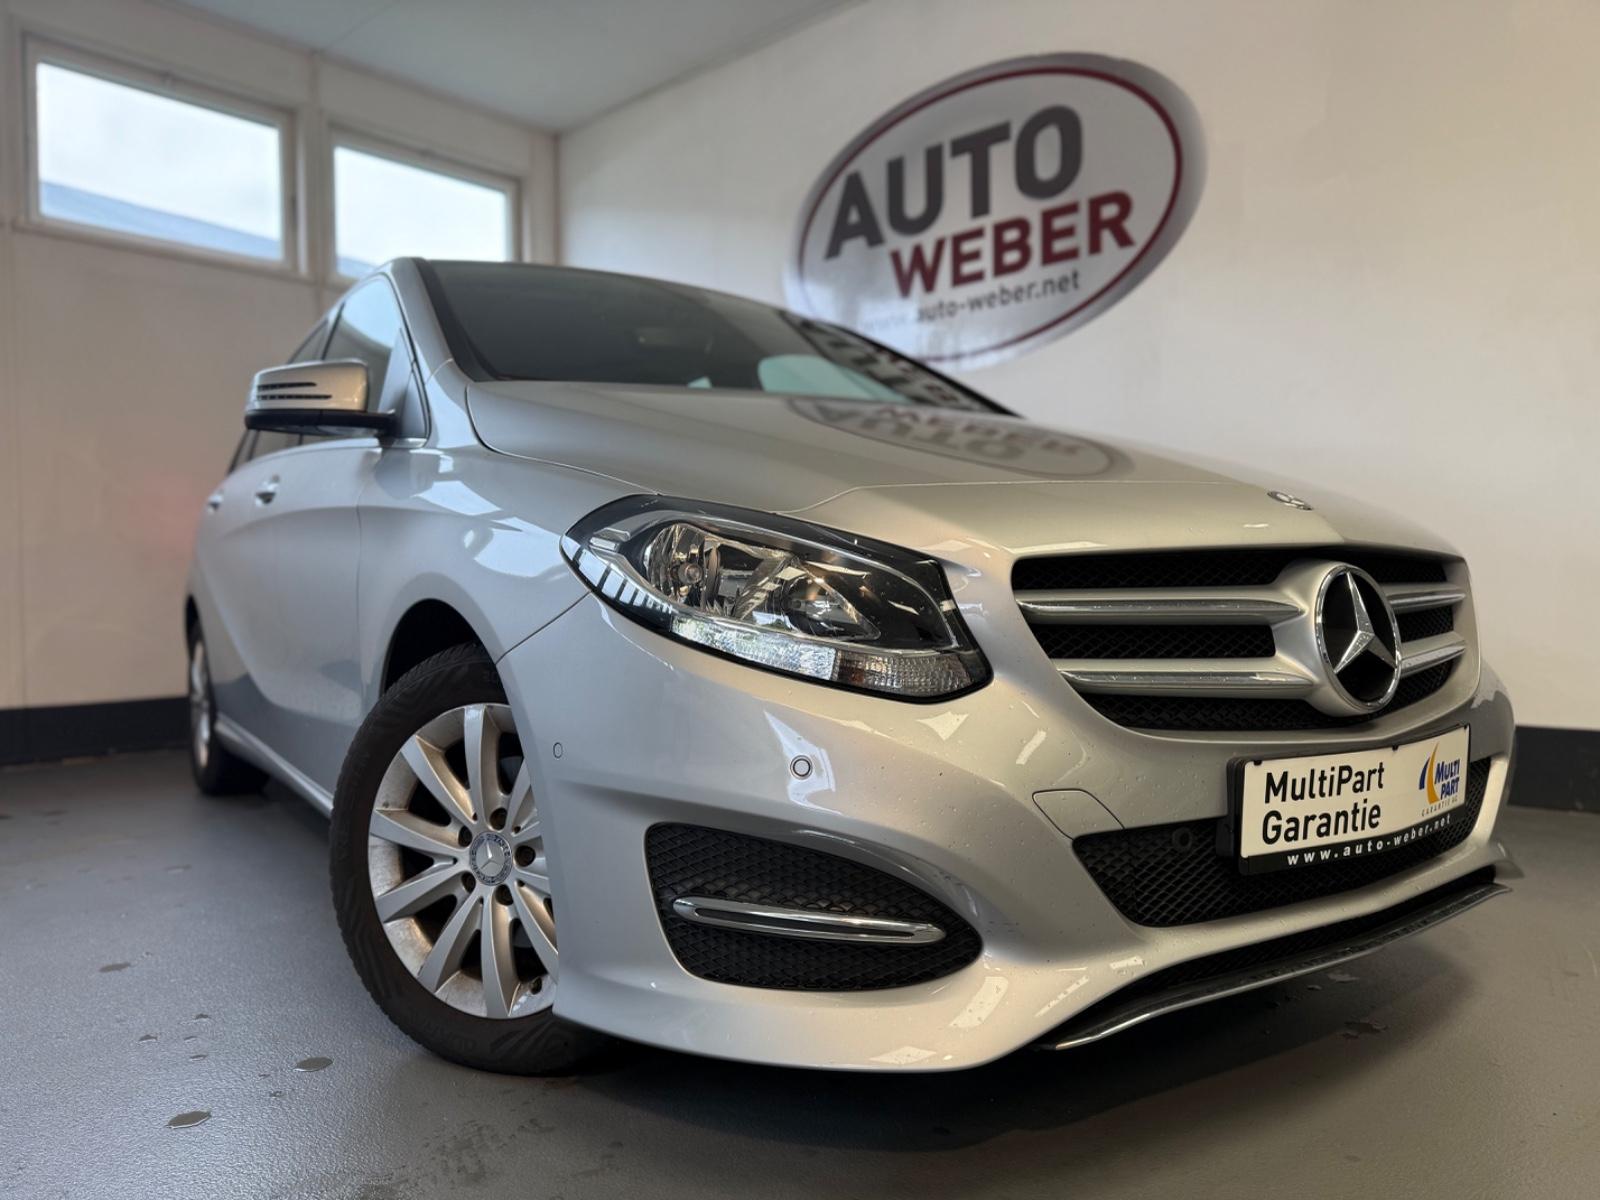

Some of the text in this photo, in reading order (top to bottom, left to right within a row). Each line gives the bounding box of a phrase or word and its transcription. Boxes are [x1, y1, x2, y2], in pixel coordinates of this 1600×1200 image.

[824, 105, 1083, 260] AUTO
[889, 191, 1135, 299] WEBER
[863, 270, 1080, 331] auto-weber.net
[1264, 761, 1385, 804] MultiPart
[1440, 777, 1460, 801] PART
[1262, 798, 1381, 845] Garantie
[1287, 813, 1451, 865] www.auto-weber.net
